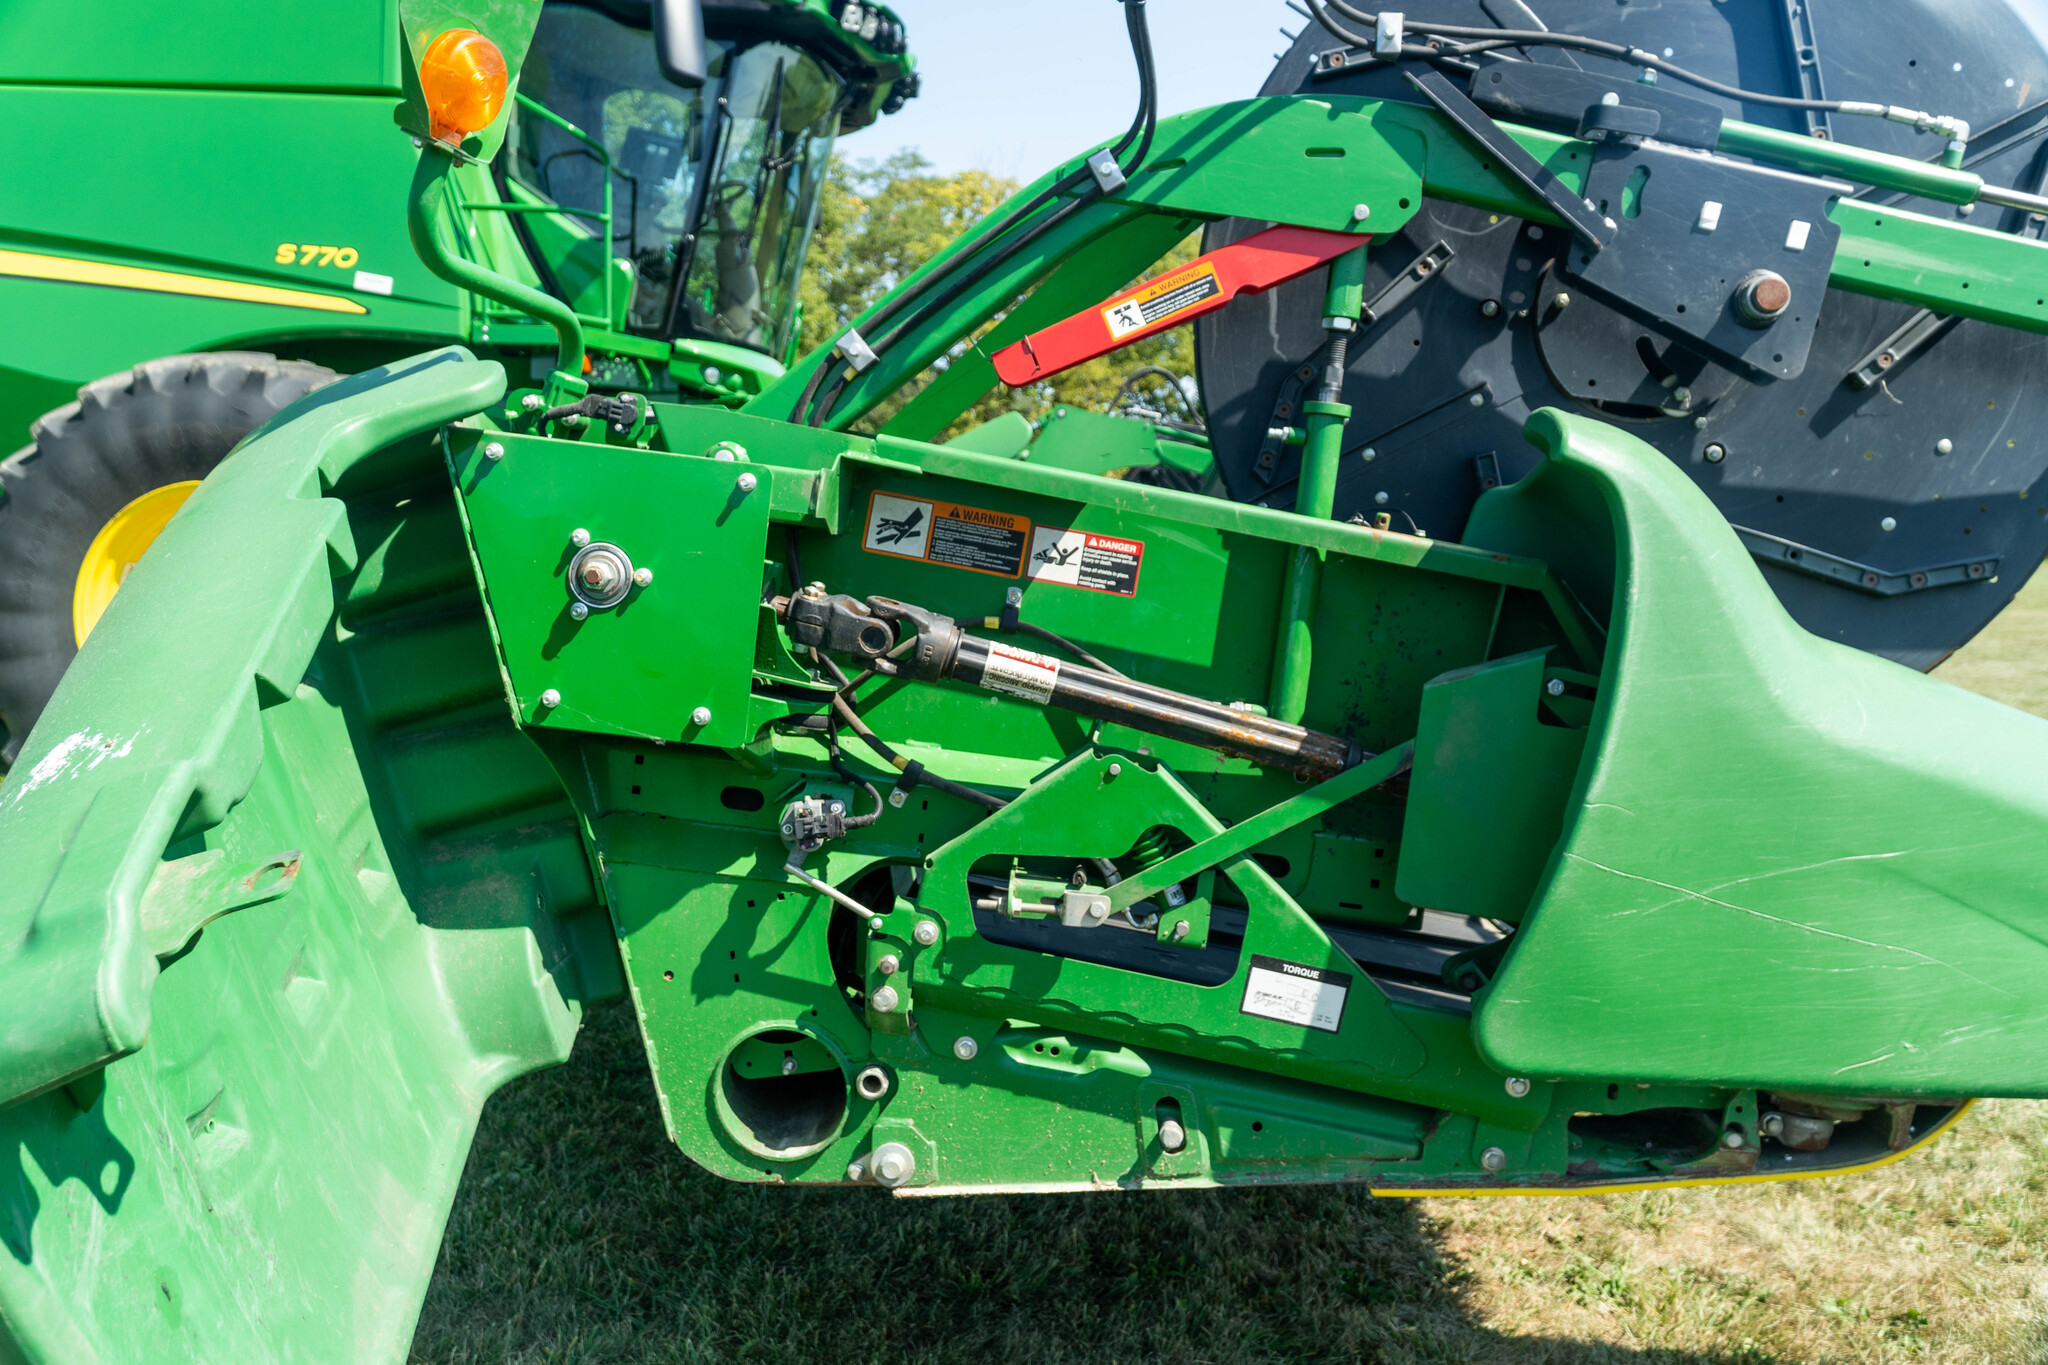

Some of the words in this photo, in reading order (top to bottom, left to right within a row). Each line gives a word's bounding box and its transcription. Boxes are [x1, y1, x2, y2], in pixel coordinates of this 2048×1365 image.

[1159, 269, 1200, 290] WARNING
[963, 509, 1015, 528] WARNING
[1099, 539, 1136, 553] DANGER
[988, 673, 1019, 686] MISSING
[1021, 682, 1048, 694] GUARD
[1283, 964, 1320, 979] TORQUE
